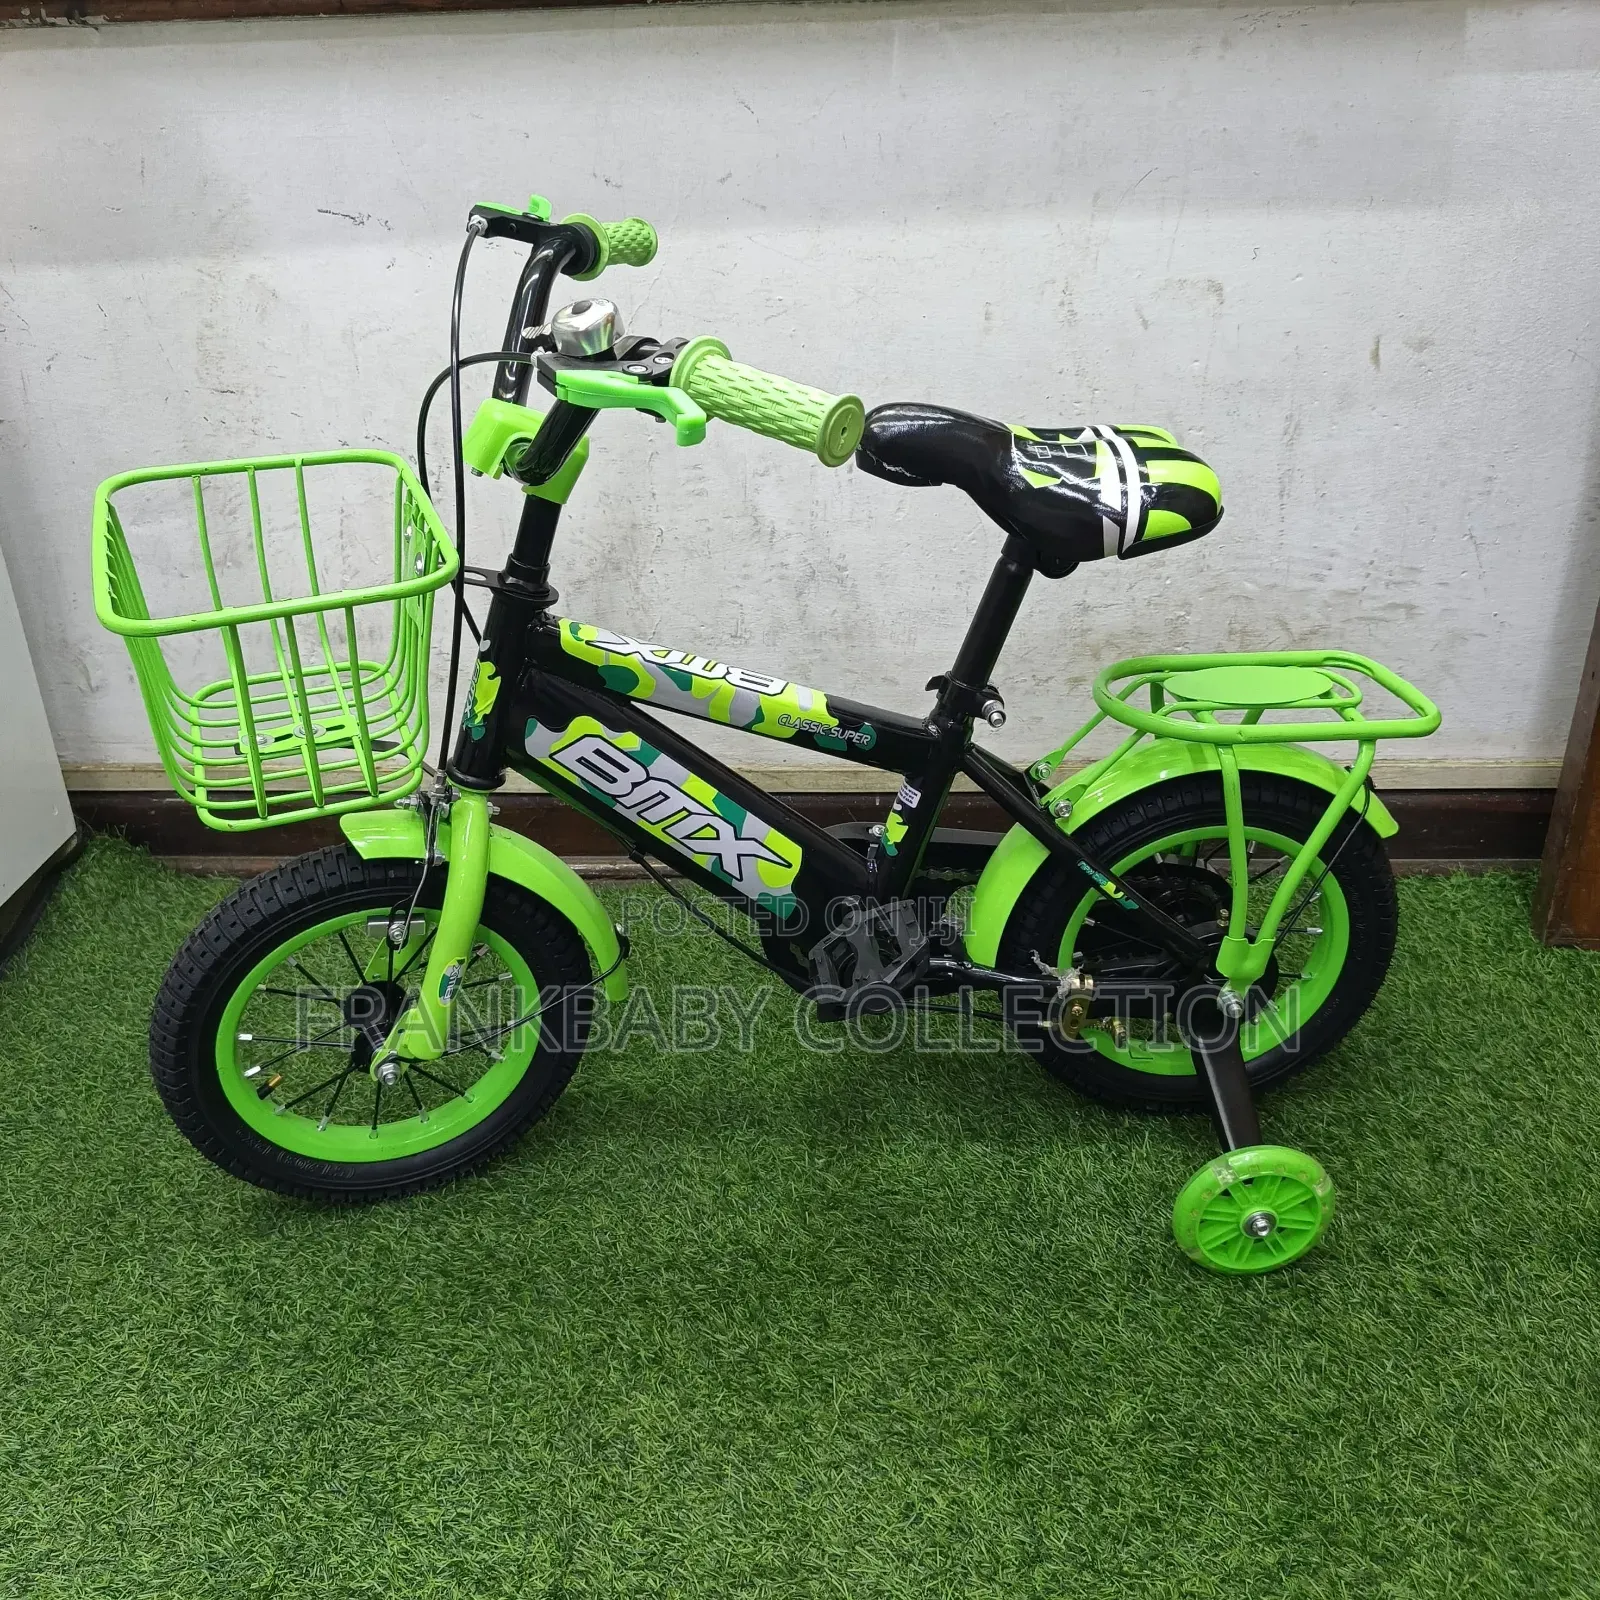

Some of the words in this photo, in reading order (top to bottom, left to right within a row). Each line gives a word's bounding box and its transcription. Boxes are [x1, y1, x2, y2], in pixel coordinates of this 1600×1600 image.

[584, 631, 789, 697] BMX
[777, 713, 830, 736] CLASSIC
[828, 727, 871, 746] SUPER
[549, 734, 793, 882] BMX
[442, 963, 462, 1000] BMX
